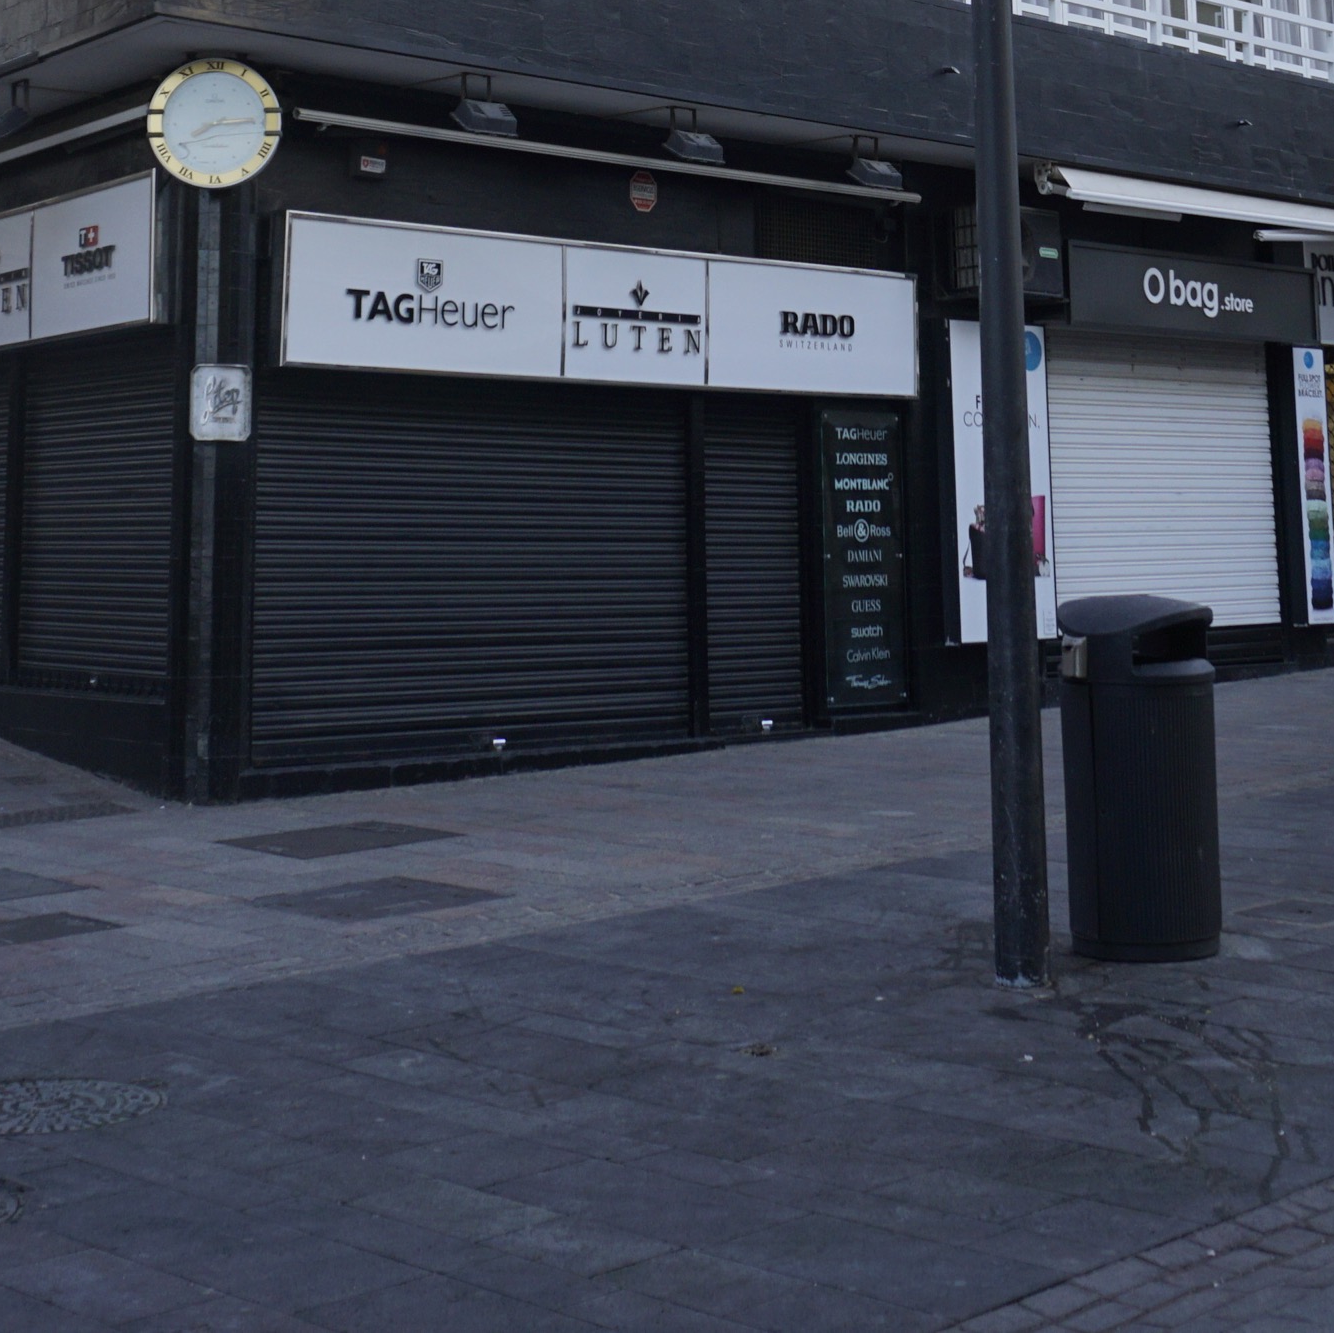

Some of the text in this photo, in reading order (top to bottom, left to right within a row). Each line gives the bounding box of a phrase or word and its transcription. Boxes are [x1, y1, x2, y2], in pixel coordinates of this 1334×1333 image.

[61, 244, 116, 277] TISSOT
[422, 263, 438, 275] TAG
[1143, 267, 1165, 304] O
[779, 311, 855, 339] RADO
[572, 321, 701, 354] LUTEN
[779, 339, 854, 353] SWITZERLAND
[835, 452, 888, 466] LONGINES
[834, 477, 889, 491] MONTBLANC
[846, 499, 881, 513] RADO
[847, 549, 882, 563] DAMIANI
[842, 574, 888, 588] SWAROVSKI
[851, 599, 882, 613] GUESS
[851, 625, 883, 638] swatch
[847, 646, 891, 663] Calvin Klein
